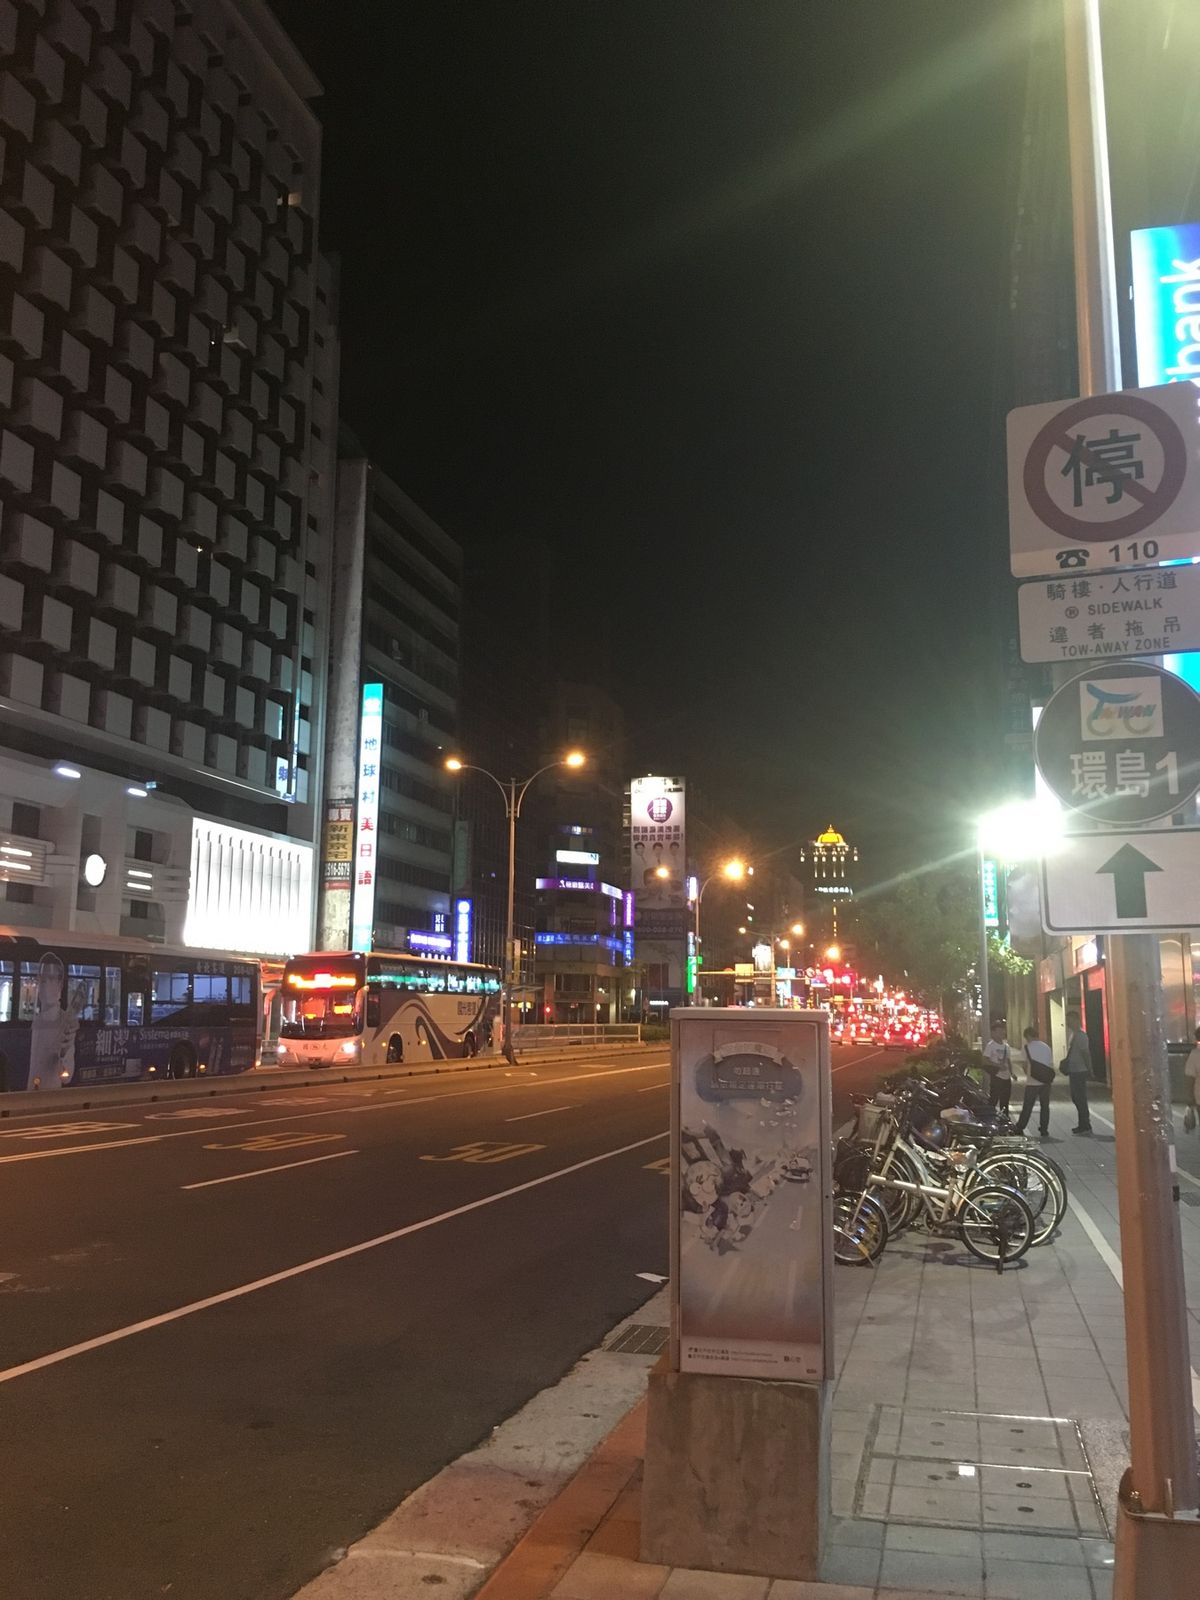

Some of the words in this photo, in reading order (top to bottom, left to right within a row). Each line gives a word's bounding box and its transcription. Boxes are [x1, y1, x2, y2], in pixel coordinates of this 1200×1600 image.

[1061, 429, 1144, 507] 停
[1108, 540, 1160, 563] 110
[1087, 598, 1163, 616] SIDEWALK
[1049, 615, 1181, 644] 違者拖吊
[1061, 641, 1130, 657] TOW-AWAY
[1135, 636, 1170, 651] ZONE
[1069, 749, 1179, 799] 環島1
[202, 1131, 348, 1152] 50
[419, 1142, 547, 1163] 50
